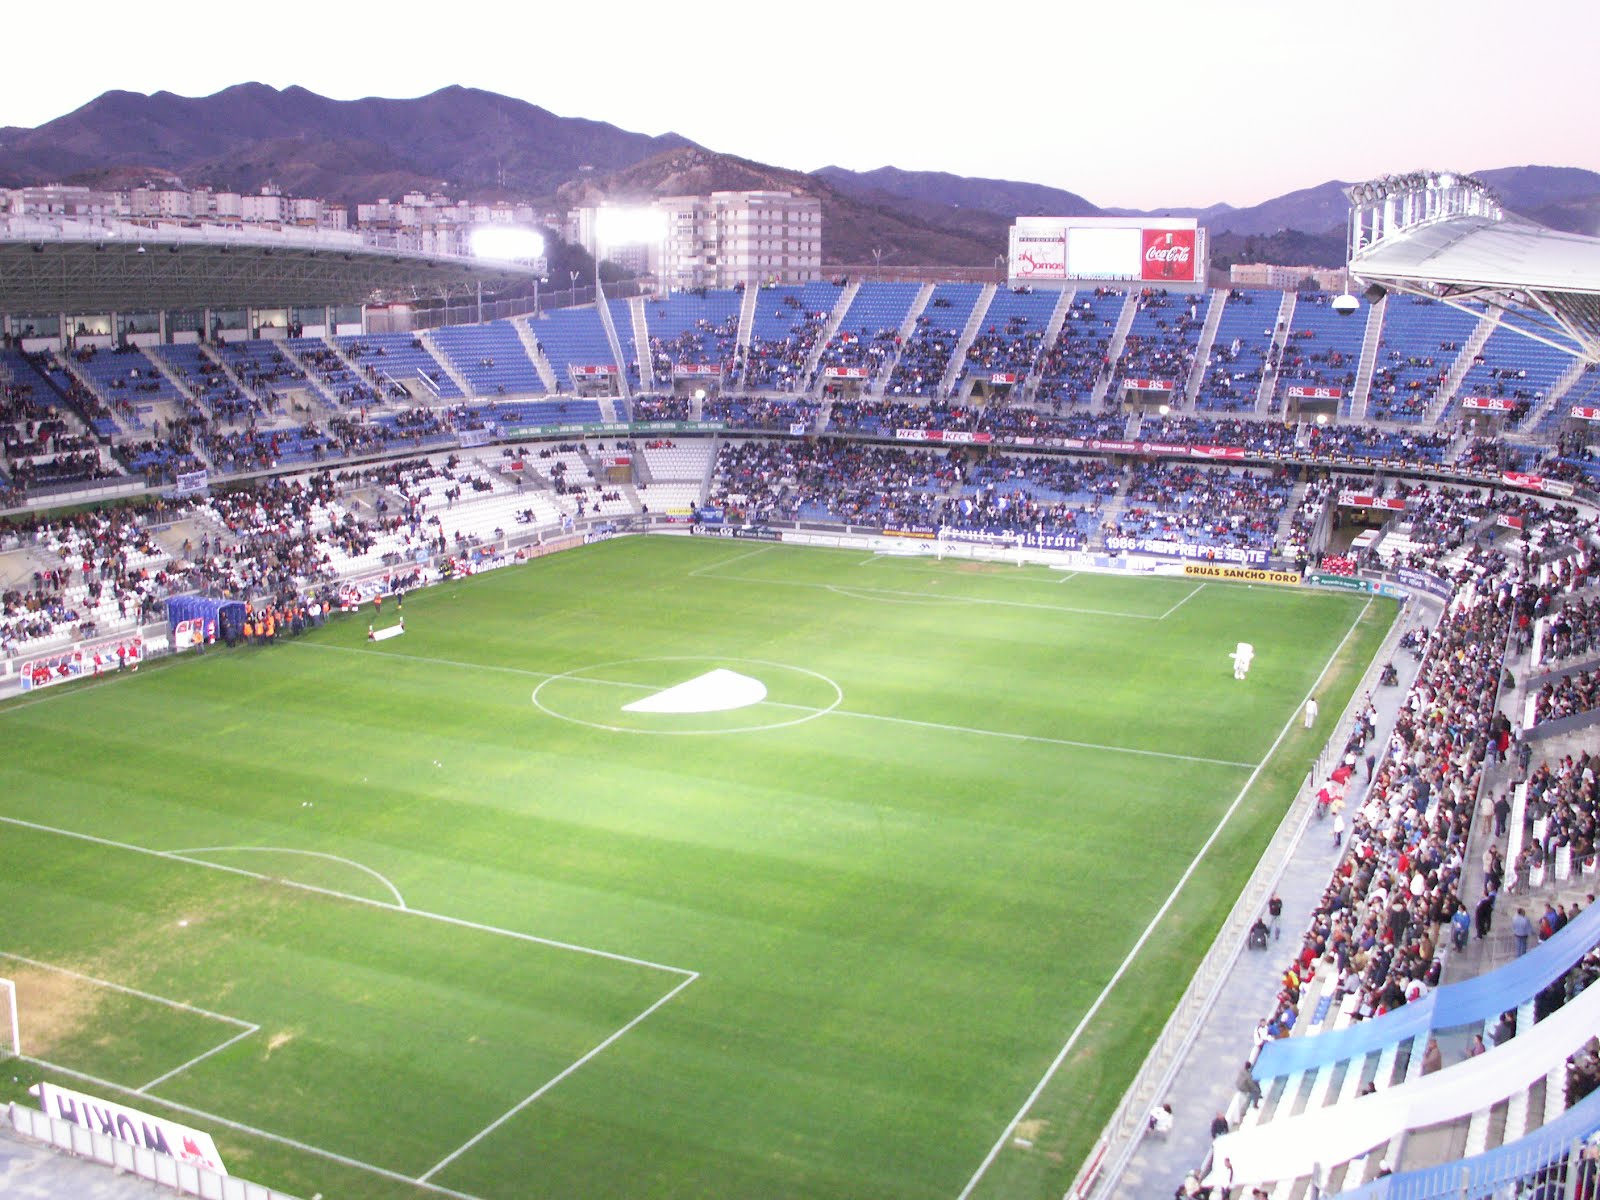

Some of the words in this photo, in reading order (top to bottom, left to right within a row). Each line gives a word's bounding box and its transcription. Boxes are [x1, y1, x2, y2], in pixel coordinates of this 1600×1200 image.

[1106, 537, 1137, 550] 1986
[1144, 539, 1197, 557] SIEMPRE
[1185, 566, 1220, 577] GRUAS
[1223, 570, 1266, 581] SANCHO
[1269, 574, 1298, 583] TORO
